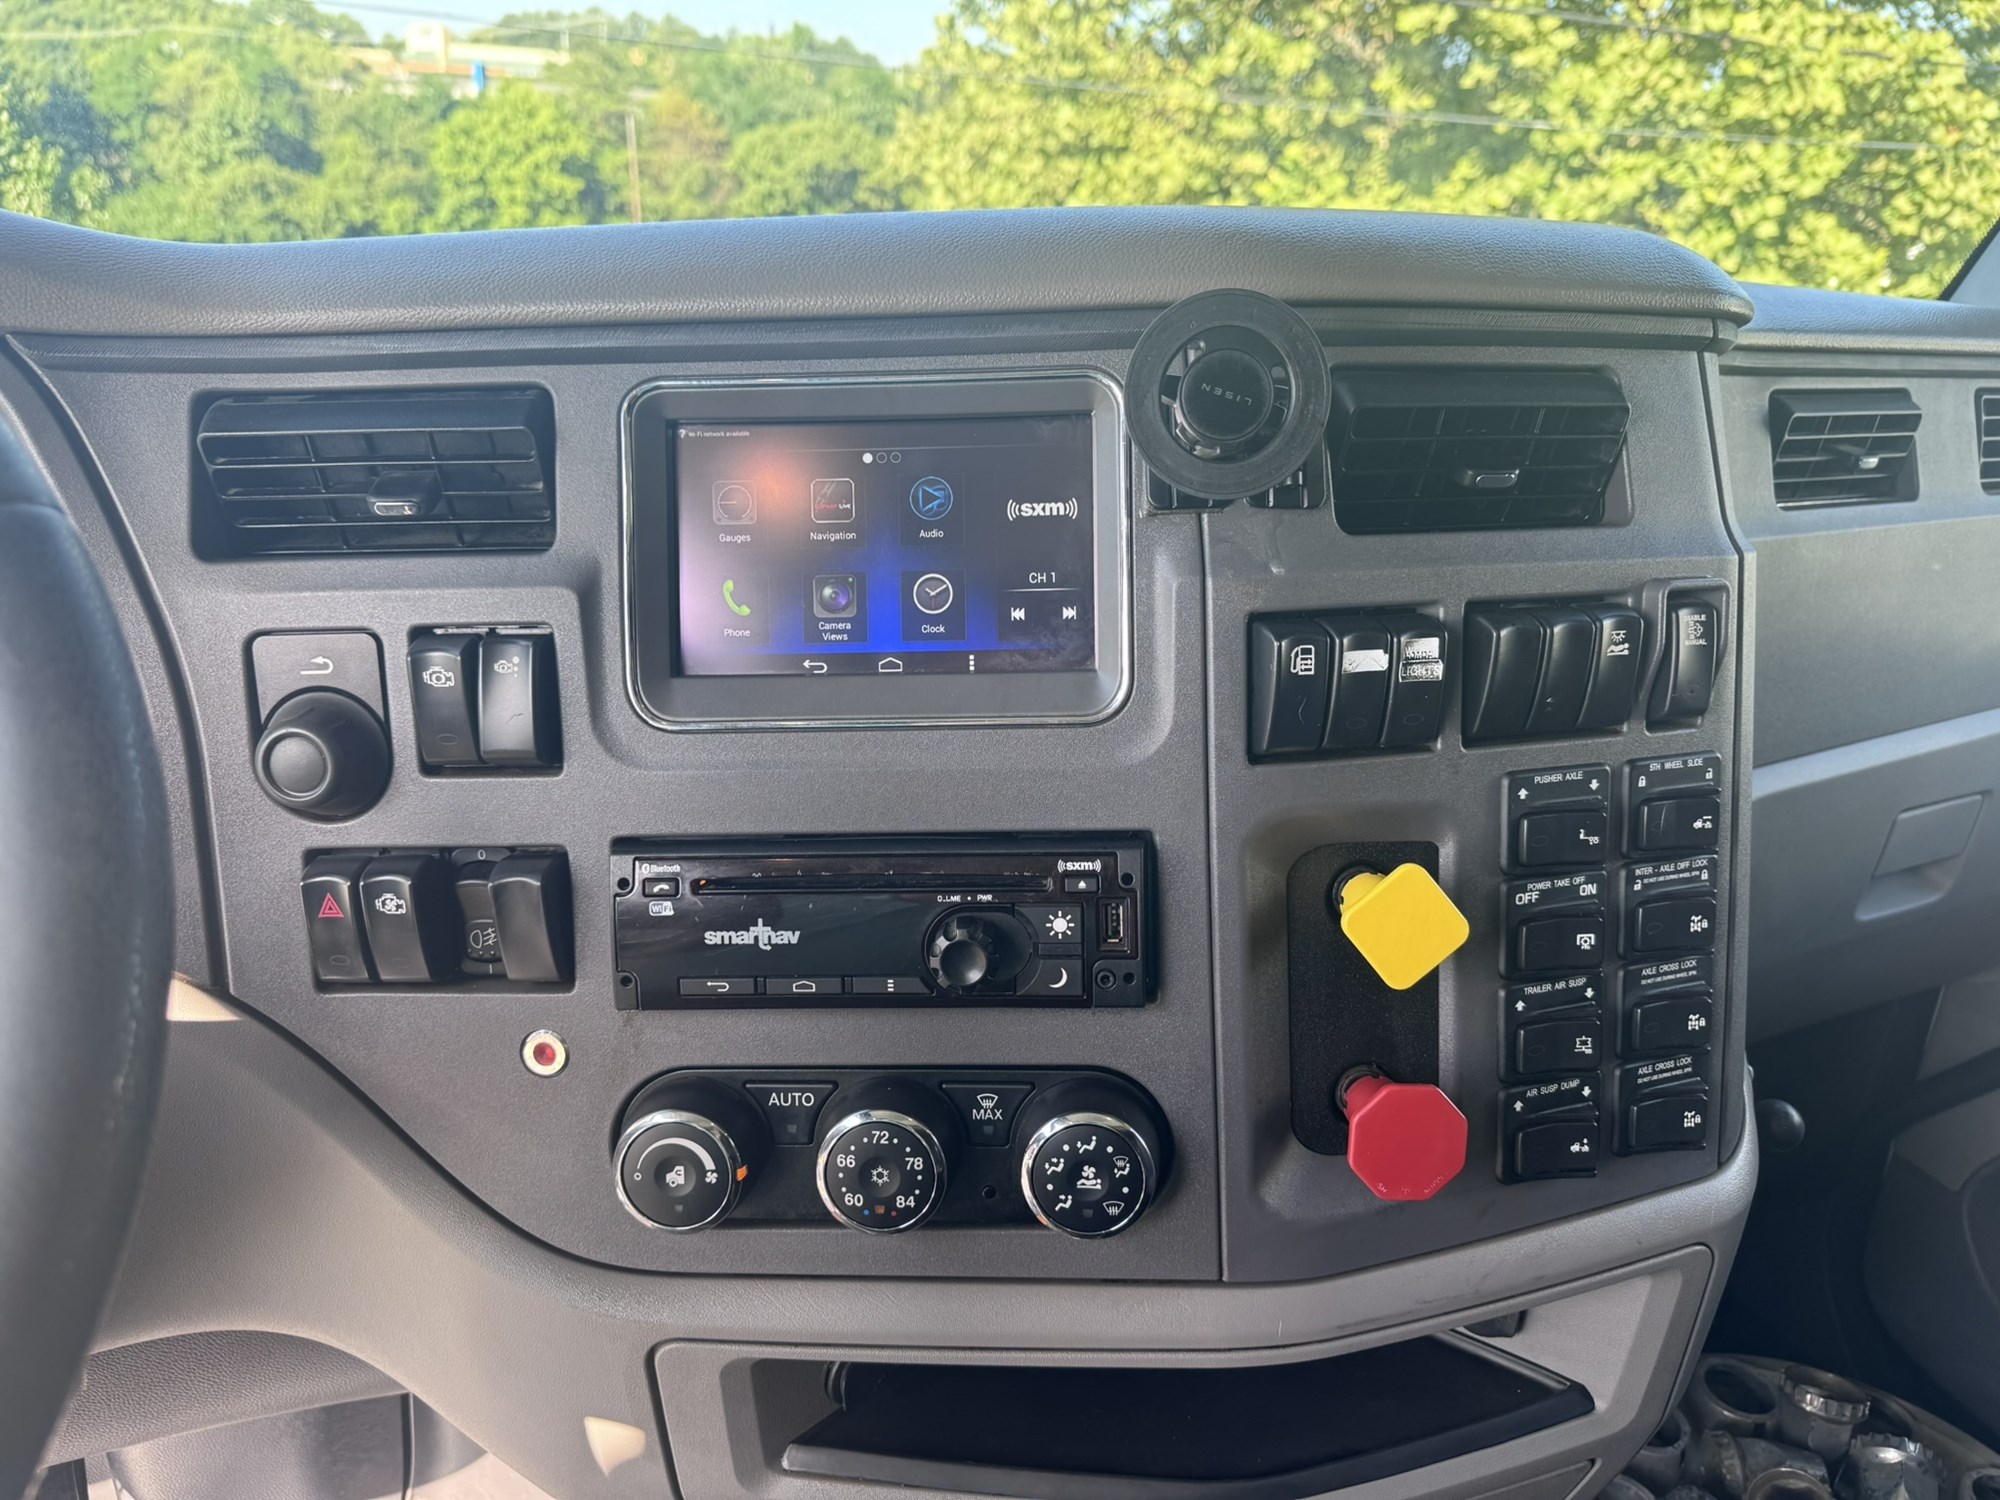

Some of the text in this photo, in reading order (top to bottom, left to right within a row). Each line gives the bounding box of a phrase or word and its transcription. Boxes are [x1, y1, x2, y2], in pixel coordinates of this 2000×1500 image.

[1201, 383, 1252, 405] LISEN
[718, 533, 751, 544] Gauges
[810, 531, 857, 542] Navigation
[919, 528, 944, 538] Audio
[1029, 572, 1056, 584] CH 1
[818, 621, 851, 631] Camera
[921, 624, 945, 634] Clock
[724, 628, 750, 638] Phone
[822, 631, 848, 641] Views
[1664, 760, 1684, 770] WHEEL
[1687, 758, 1703, 767] SLIDE
[1534, 770, 1583, 784] PUSHER AXLE
[650, 864, 680, 873] Bluetooth
[1635, 866, 1653, 876] INTER
[1659, 863, 1675, 872] AXLE
[1677, 861, 1690, 870] DIFF
[1692, 859, 1708, 868] LOCK
[1527, 876, 1585, 891] POWER TAKE OFF
[1579, 883, 1597, 896] ON
[977, 894, 993, 902] PWR
[1515, 891, 1540, 905] OFF
[704, 918, 800, 951] smartnav
[1641, 959, 1697, 976] AXLE CROSS LOCK
[1524, 977, 1586, 995] TRAILER AIR SUSP
[1637, 1056, 1692, 1075] AXLE CROSS LOCK
[1526, 1079, 1580, 1098] AIR SUSP DUMP
[768, 1092, 815, 1107] AUTO
[972, 1108, 1003, 1120] MAX
[871, 1131, 889, 1144] 72
[836, 1154, 856, 1168] 66
[905, 1157, 923, 1170] 78
[844, 1193, 864, 1206] 60
[896, 1195, 915, 1208] 84
